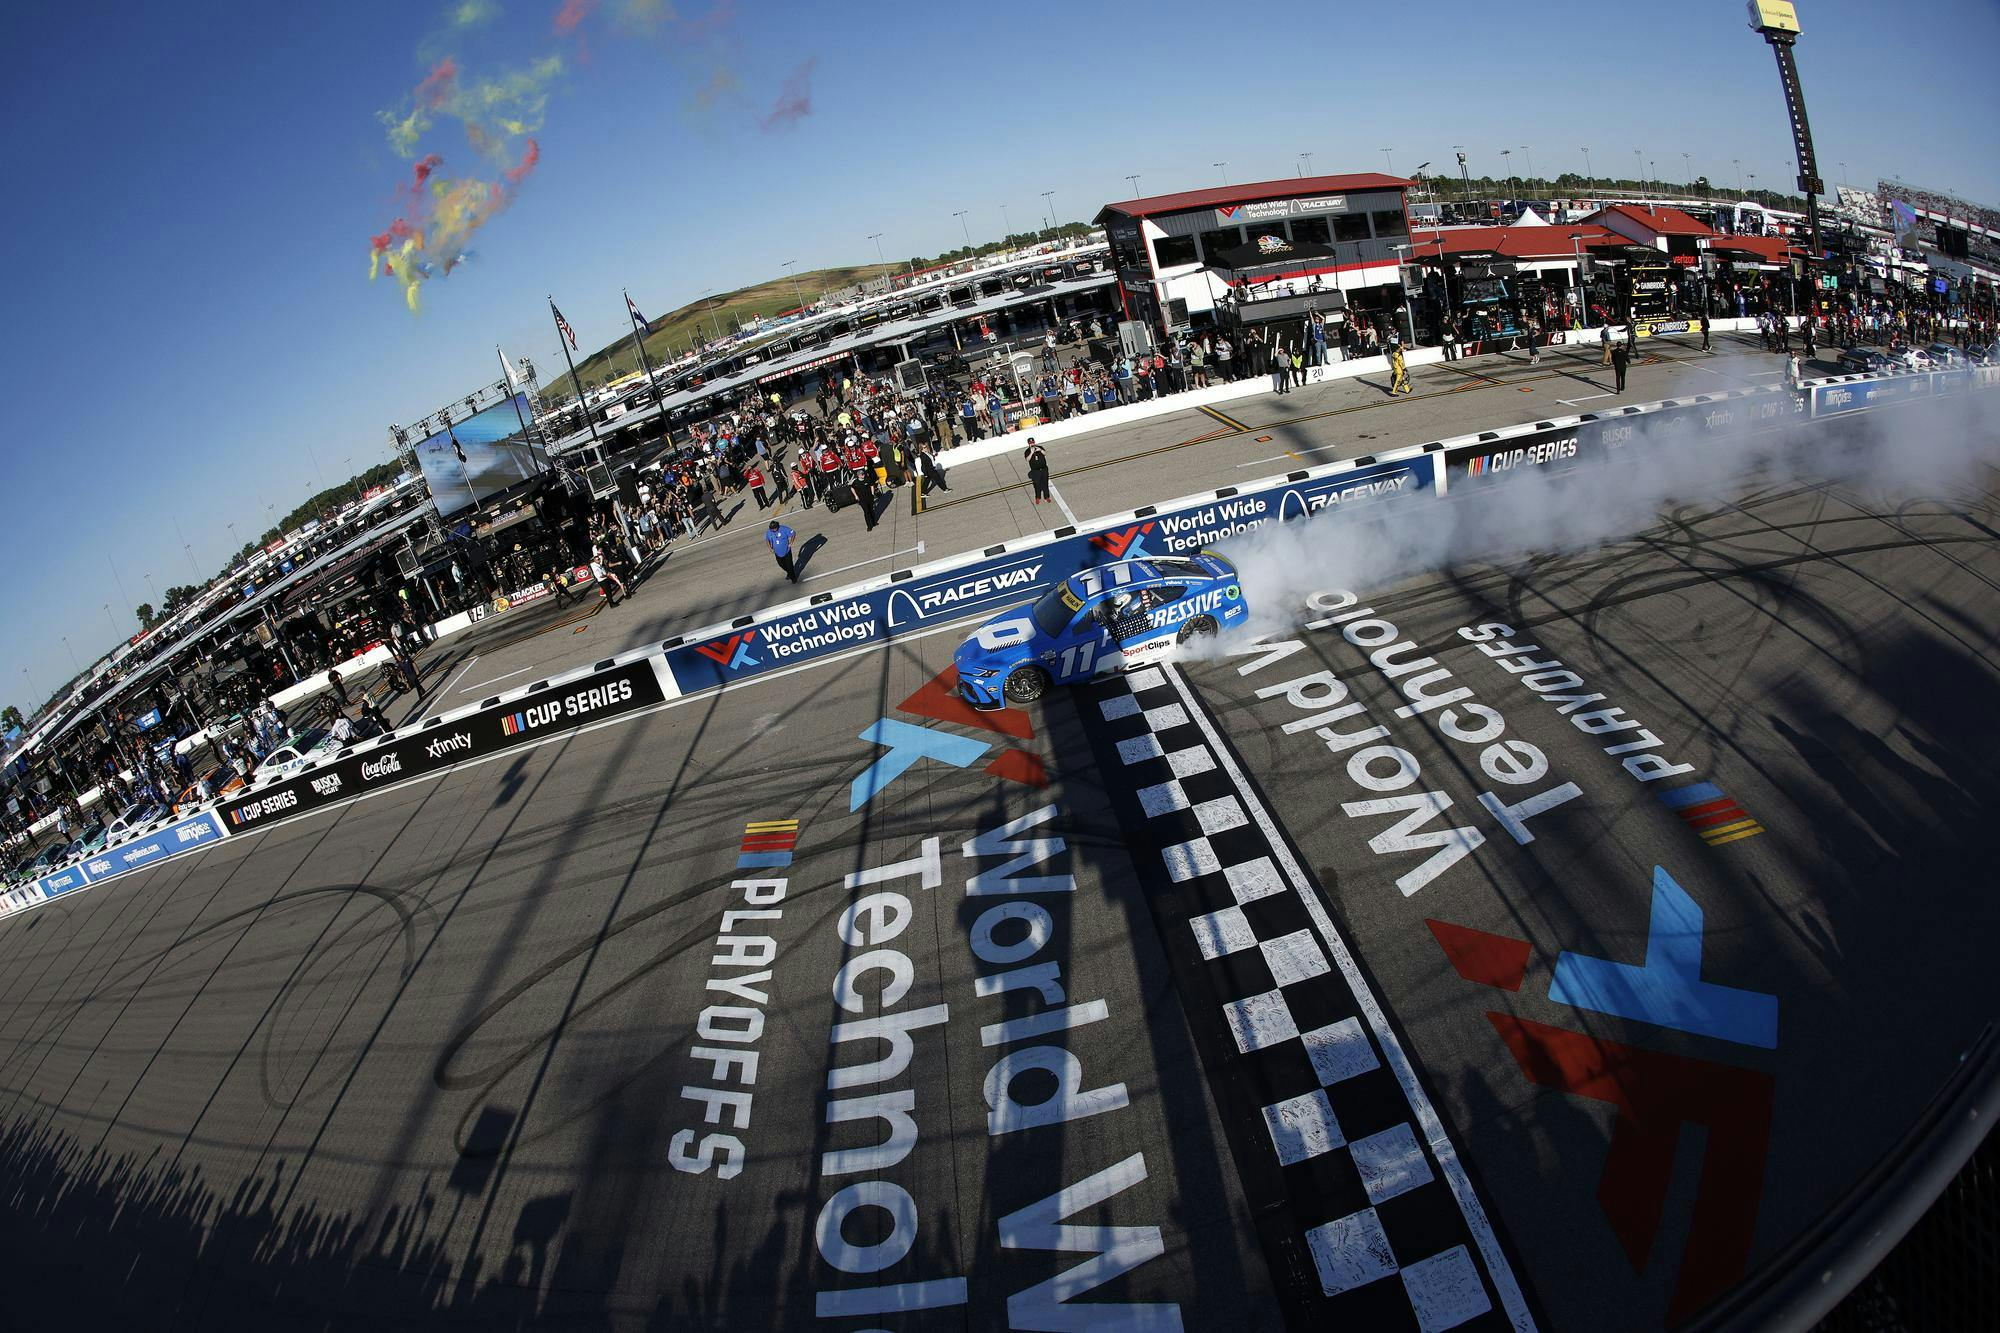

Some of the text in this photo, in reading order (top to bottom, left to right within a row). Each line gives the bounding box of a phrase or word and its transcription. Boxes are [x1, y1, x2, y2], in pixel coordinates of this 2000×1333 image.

[1246, 200, 1288, 212] World Wide
[1248, 208, 1289, 219] Technology
[1302, 199, 1343, 209] RACEWAY
[1672, 255, 1696, 265] verizon
[1640, 280, 1666, 291] GAINBRIDGE
[1747, 268, 1758, 287] 7
[1822, 274, 1838, 289] 54
[1657, 320, 1689, 333] GAINBRIDGE
[1551, 332, 1564, 345] 45
[1312, 368, 1324, 380] 20
[1011, 406, 1041, 421] NACA
[1705, 410, 1735, 429] xfinity
[1602, 426, 1632, 445] BUSCH
[1491, 437, 1578, 474] CUP SERIES
[1308, 475, 1409, 511] RACEWAY
[1158, 498, 1267, 536] World Wide
[510, 582, 545, 601] TRACKER
[919, 563, 1043, 610] RACEWAY
[471, 604, 485, 622] 19
[760, 600, 873, 643] World Wide
[767, 619, 876, 660] Technology
[1123, 639, 1171, 657] SportClips
[356, 656, 366, 667] 22
[1061, 641, 1097, 679] 11
[525, 678, 633, 729] CUP SERIES
[1457, 622, 1695, 782] PLAYOFFS
[1305, 588, 1584, 845] Technolo
[425, 732, 471, 759] xfinity
[361, 752, 402, 781] Coca-Cola
[311, 773, 342, 794] BUSCH
[1254, 669, 1487, 897] World
[242, 789, 298, 821] CUP SERIES
[961, 804, 1130, 1136] World
[667, 877, 789, 1180] PLAYOFFS
[815, 836, 969, 1333] Technol
